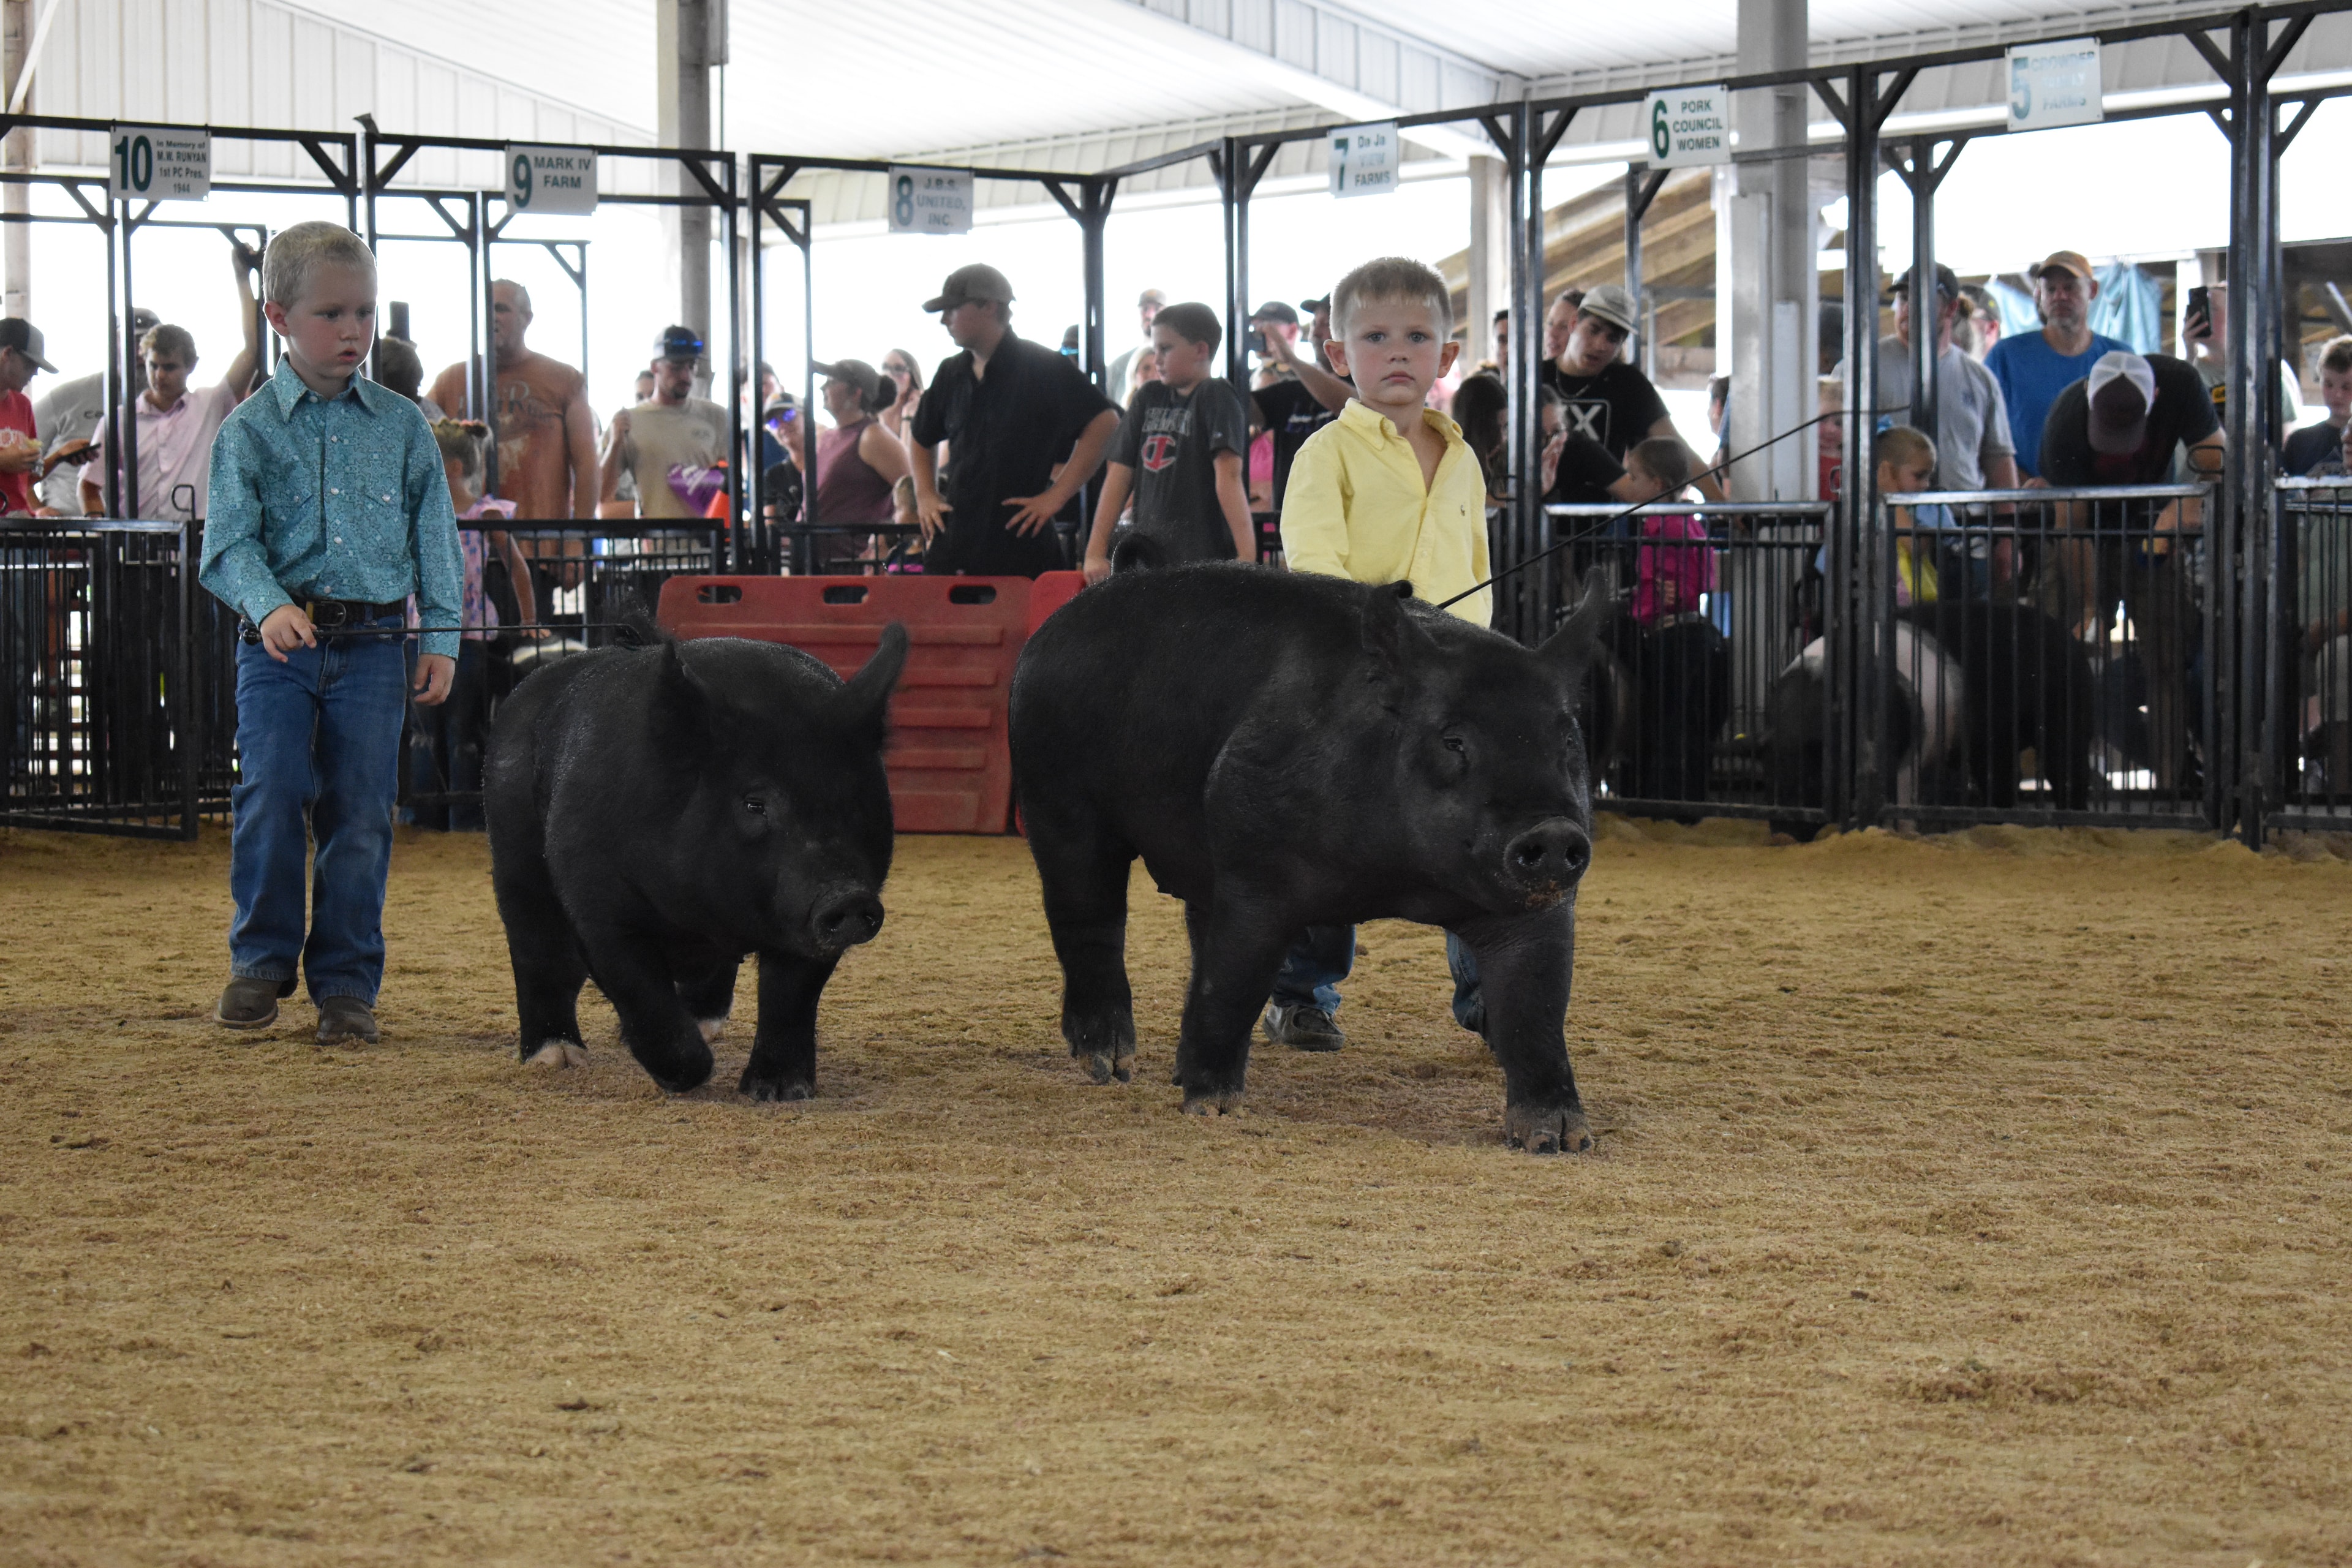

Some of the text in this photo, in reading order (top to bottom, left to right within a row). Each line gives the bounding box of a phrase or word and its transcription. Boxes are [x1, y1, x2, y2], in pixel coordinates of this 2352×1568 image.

[2012, 57, 2031, 120] 5
[1681, 100, 1711, 113] PORK
[1653, 100, 1669, 159] 6
[1673, 118, 1722, 133] COUNCIL
[166, 140, 195, 149] Memory
[1677, 137, 1720, 150] WOMEN
[115, 135, 153, 192] 10
[157, 151, 206, 162] M.W. RUNYAN
[534, 156, 590, 170] MARK IV
[1334, 138, 1349, 190] 7
[159, 167, 205, 178] 1st PC Pres.
[1354, 171, 1390, 187] FARMS
[173, 183, 190, 193] 1944
[513, 154, 532, 208] 9
[544, 175, 581, 189] FARM
[895, 175, 913, 226] 8
